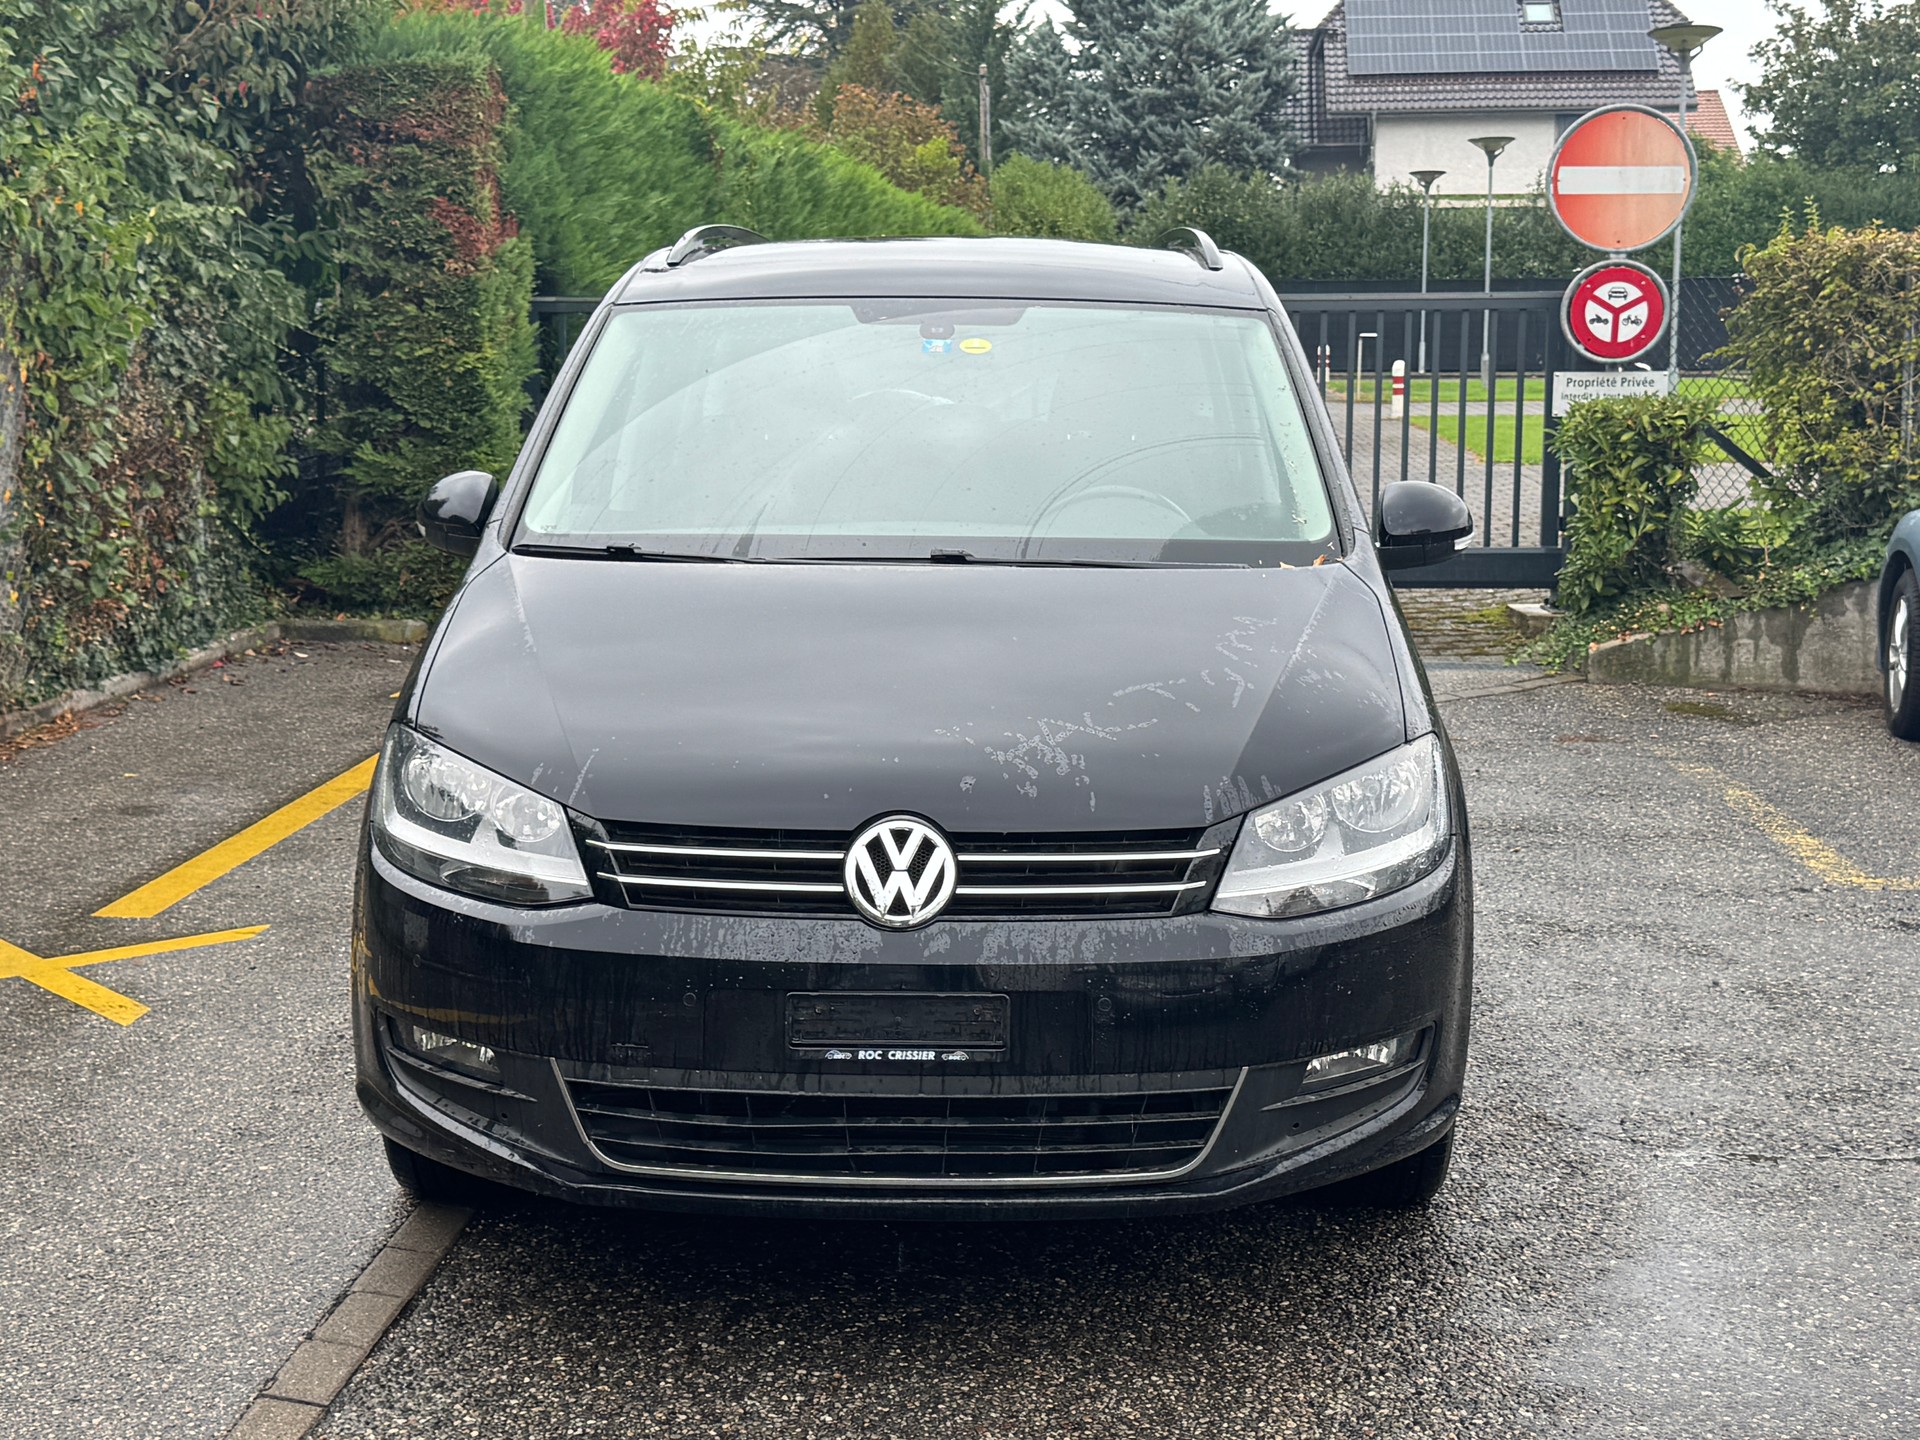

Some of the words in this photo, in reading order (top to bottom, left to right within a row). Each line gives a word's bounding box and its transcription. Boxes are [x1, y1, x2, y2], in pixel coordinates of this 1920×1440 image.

[1566, 377, 1617, 390] Propriété
[1620, 377, 1655, 388] Privée
[845, 815, 956, 926] VW
[858, 1050, 883, 1060] ROC
[887, 1050, 936, 1061] CRISSIER
